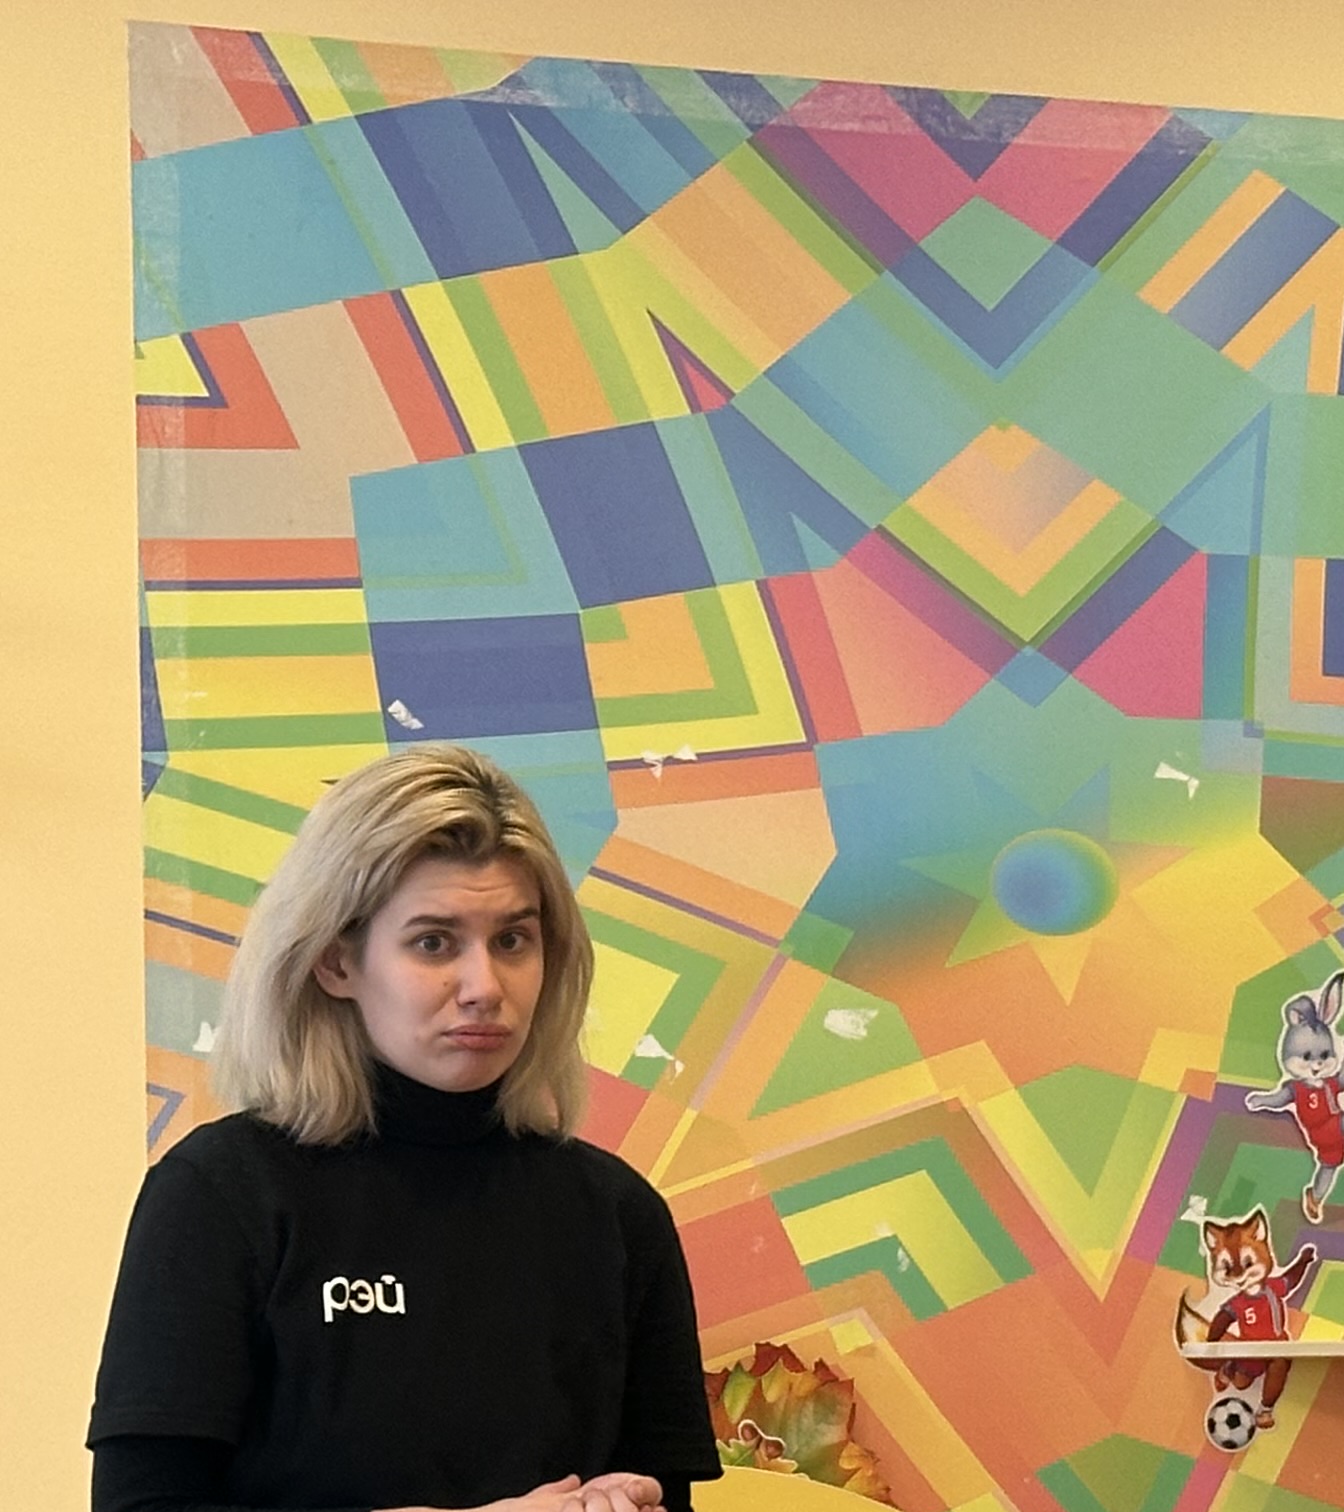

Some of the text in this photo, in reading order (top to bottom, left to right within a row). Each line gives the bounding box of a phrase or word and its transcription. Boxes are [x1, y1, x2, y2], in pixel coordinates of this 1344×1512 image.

[1308, 1092, 1319, 1109] 3
[322, 1274, 407, 1323] рэй
[1244, 1306, 1257, 1325] 5
